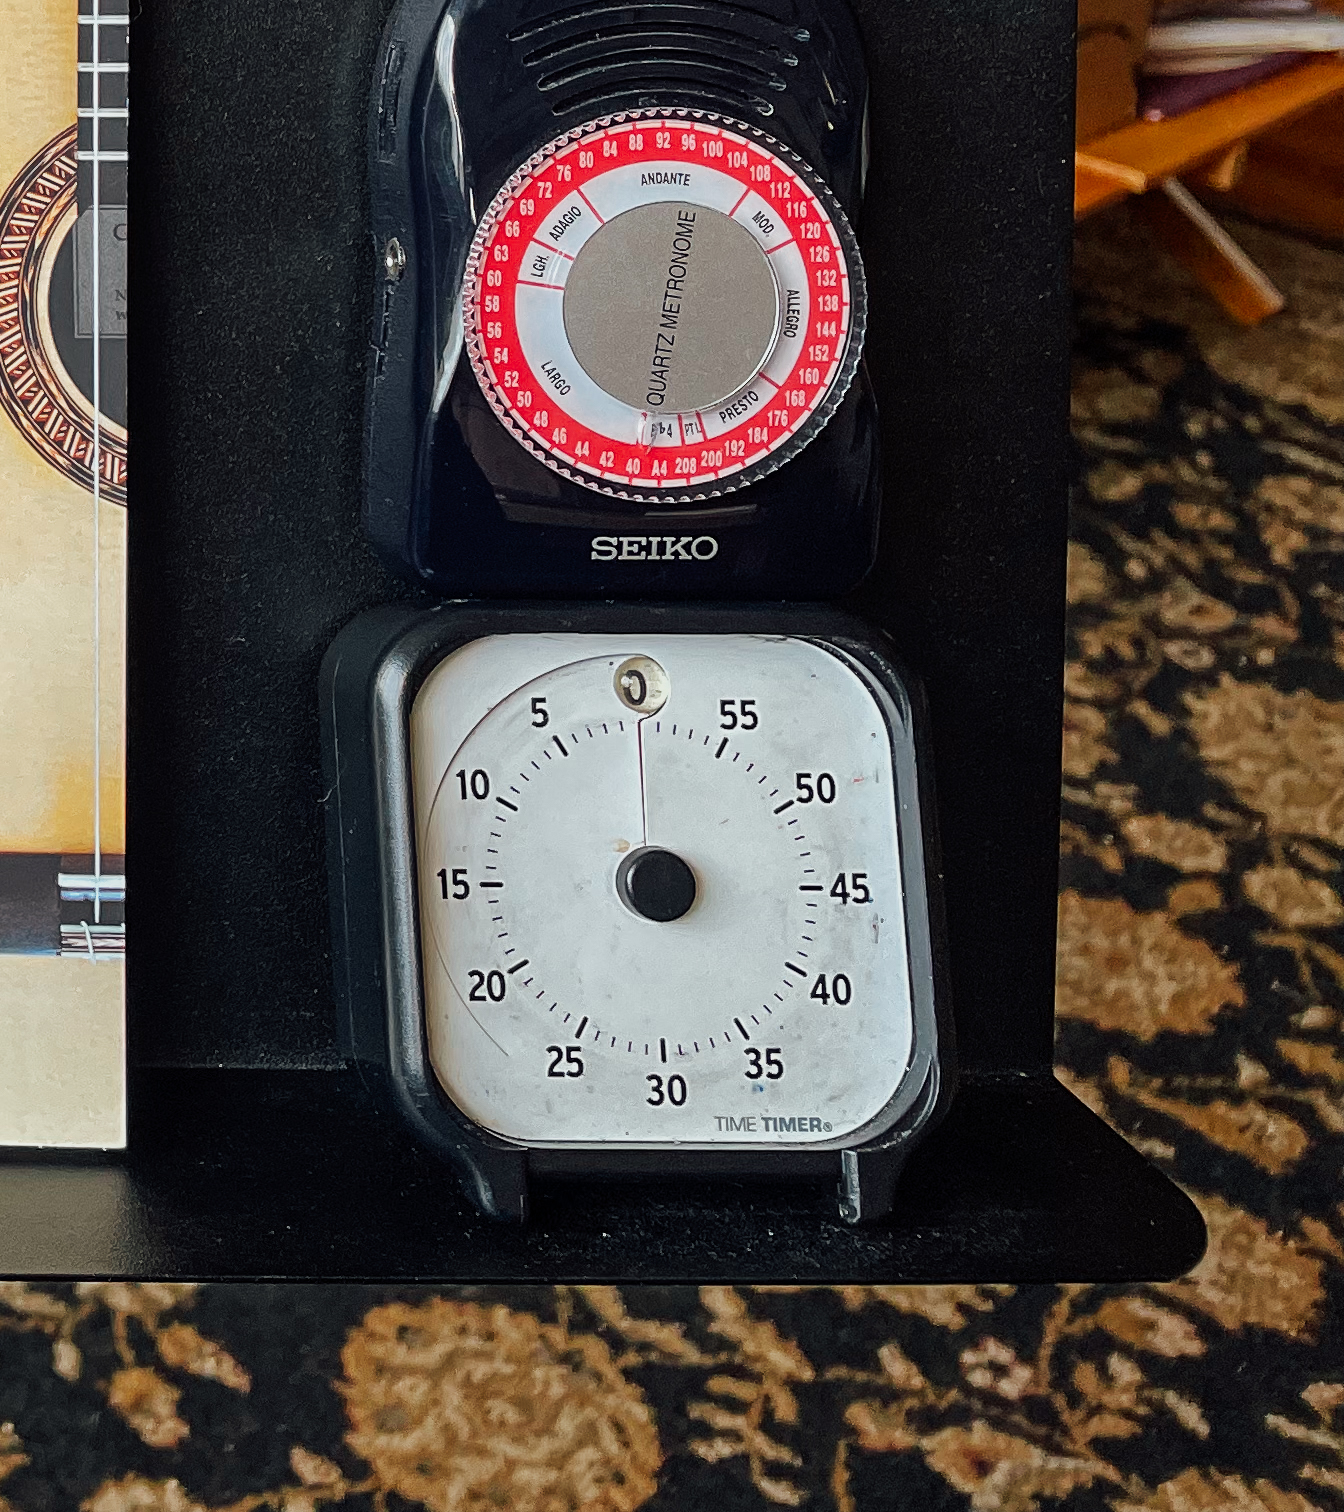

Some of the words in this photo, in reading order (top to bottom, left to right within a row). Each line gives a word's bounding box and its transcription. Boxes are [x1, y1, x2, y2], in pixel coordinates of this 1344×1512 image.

[603, 141, 618, 157] 84
[629, 134, 643, 150] 88
[656, 132, 671, 149] 92
[682, 134, 696, 151] 96
[702, 141, 724, 158] 100
[579, 151, 594, 168] 80
[727, 151, 748, 168] 104
[556, 165, 572, 182] 76
[641, 172, 690, 186] ANDANTE
[749, 164, 771, 182] 108
[538, 182, 553, 198] 72
[770, 182, 791, 199] 112
[520, 199, 535, 216] 69
[786, 202, 808, 218] 116
[505, 221, 520, 237] 66
[549, 206, 582, 241] ADAGIO
[800, 223, 821, 239] 120
[494, 245, 509, 262] 63
[809, 246, 830, 263] 126
[487, 270, 502, 286] 60
[659, 210, 697, 330] METRONOME
[816, 270, 837, 287] 132
[485, 295, 499, 312] 58
[818, 295, 839, 312] 138
[784, 289, 800, 338] ALLEGRO
[487, 322, 502, 339] 56
[816, 321, 837, 338] 144
[494, 347, 509, 364] 54
[809, 345, 829, 361] 152
[540, 360, 571, 396] LARGO
[646, 333, 675, 406] QUARTZ
[799, 368, 819, 385] 160
[504, 371, 519, 388] 52
[517, 391, 532, 407] 50
[719, 390, 759, 424] PRESTO
[785, 390, 806, 407] 168
[533, 411, 549, 427] 48
[767, 410, 789, 427] 176
[552, 427, 567, 444] 46
[747, 427, 769, 444] 184
[574, 441, 590, 457] 44
[724, 440, 746, 457] 192
[599, 451, 615, 468] 42
[625, 458, 641, 475] 40
[674, 457, 697, 474] 208
[701, 450, 723, 467] 200
[651, 460, 668, 476] A4
[591, 537, 718, 560] SEIKO
[625, 668, 646, 704] 0
[530, 698, 549, 727] 5
[720, 700, 758, 730] 55
[457, 769, 490, 800] 10
[796, 773, 835, 803] 50
[438, 869, 470, 900] 15
[830, 873, 870, 904] 45
[468, 970, 505, 1001] 20
[810, 974, 851, 1005] 40
[546, 1046, 584, 1078] 25
[744, 1049, 784, 1080] 35
[646, 1076, 687, 1106] 30
[714, 1116, 757, 1132] TIME
